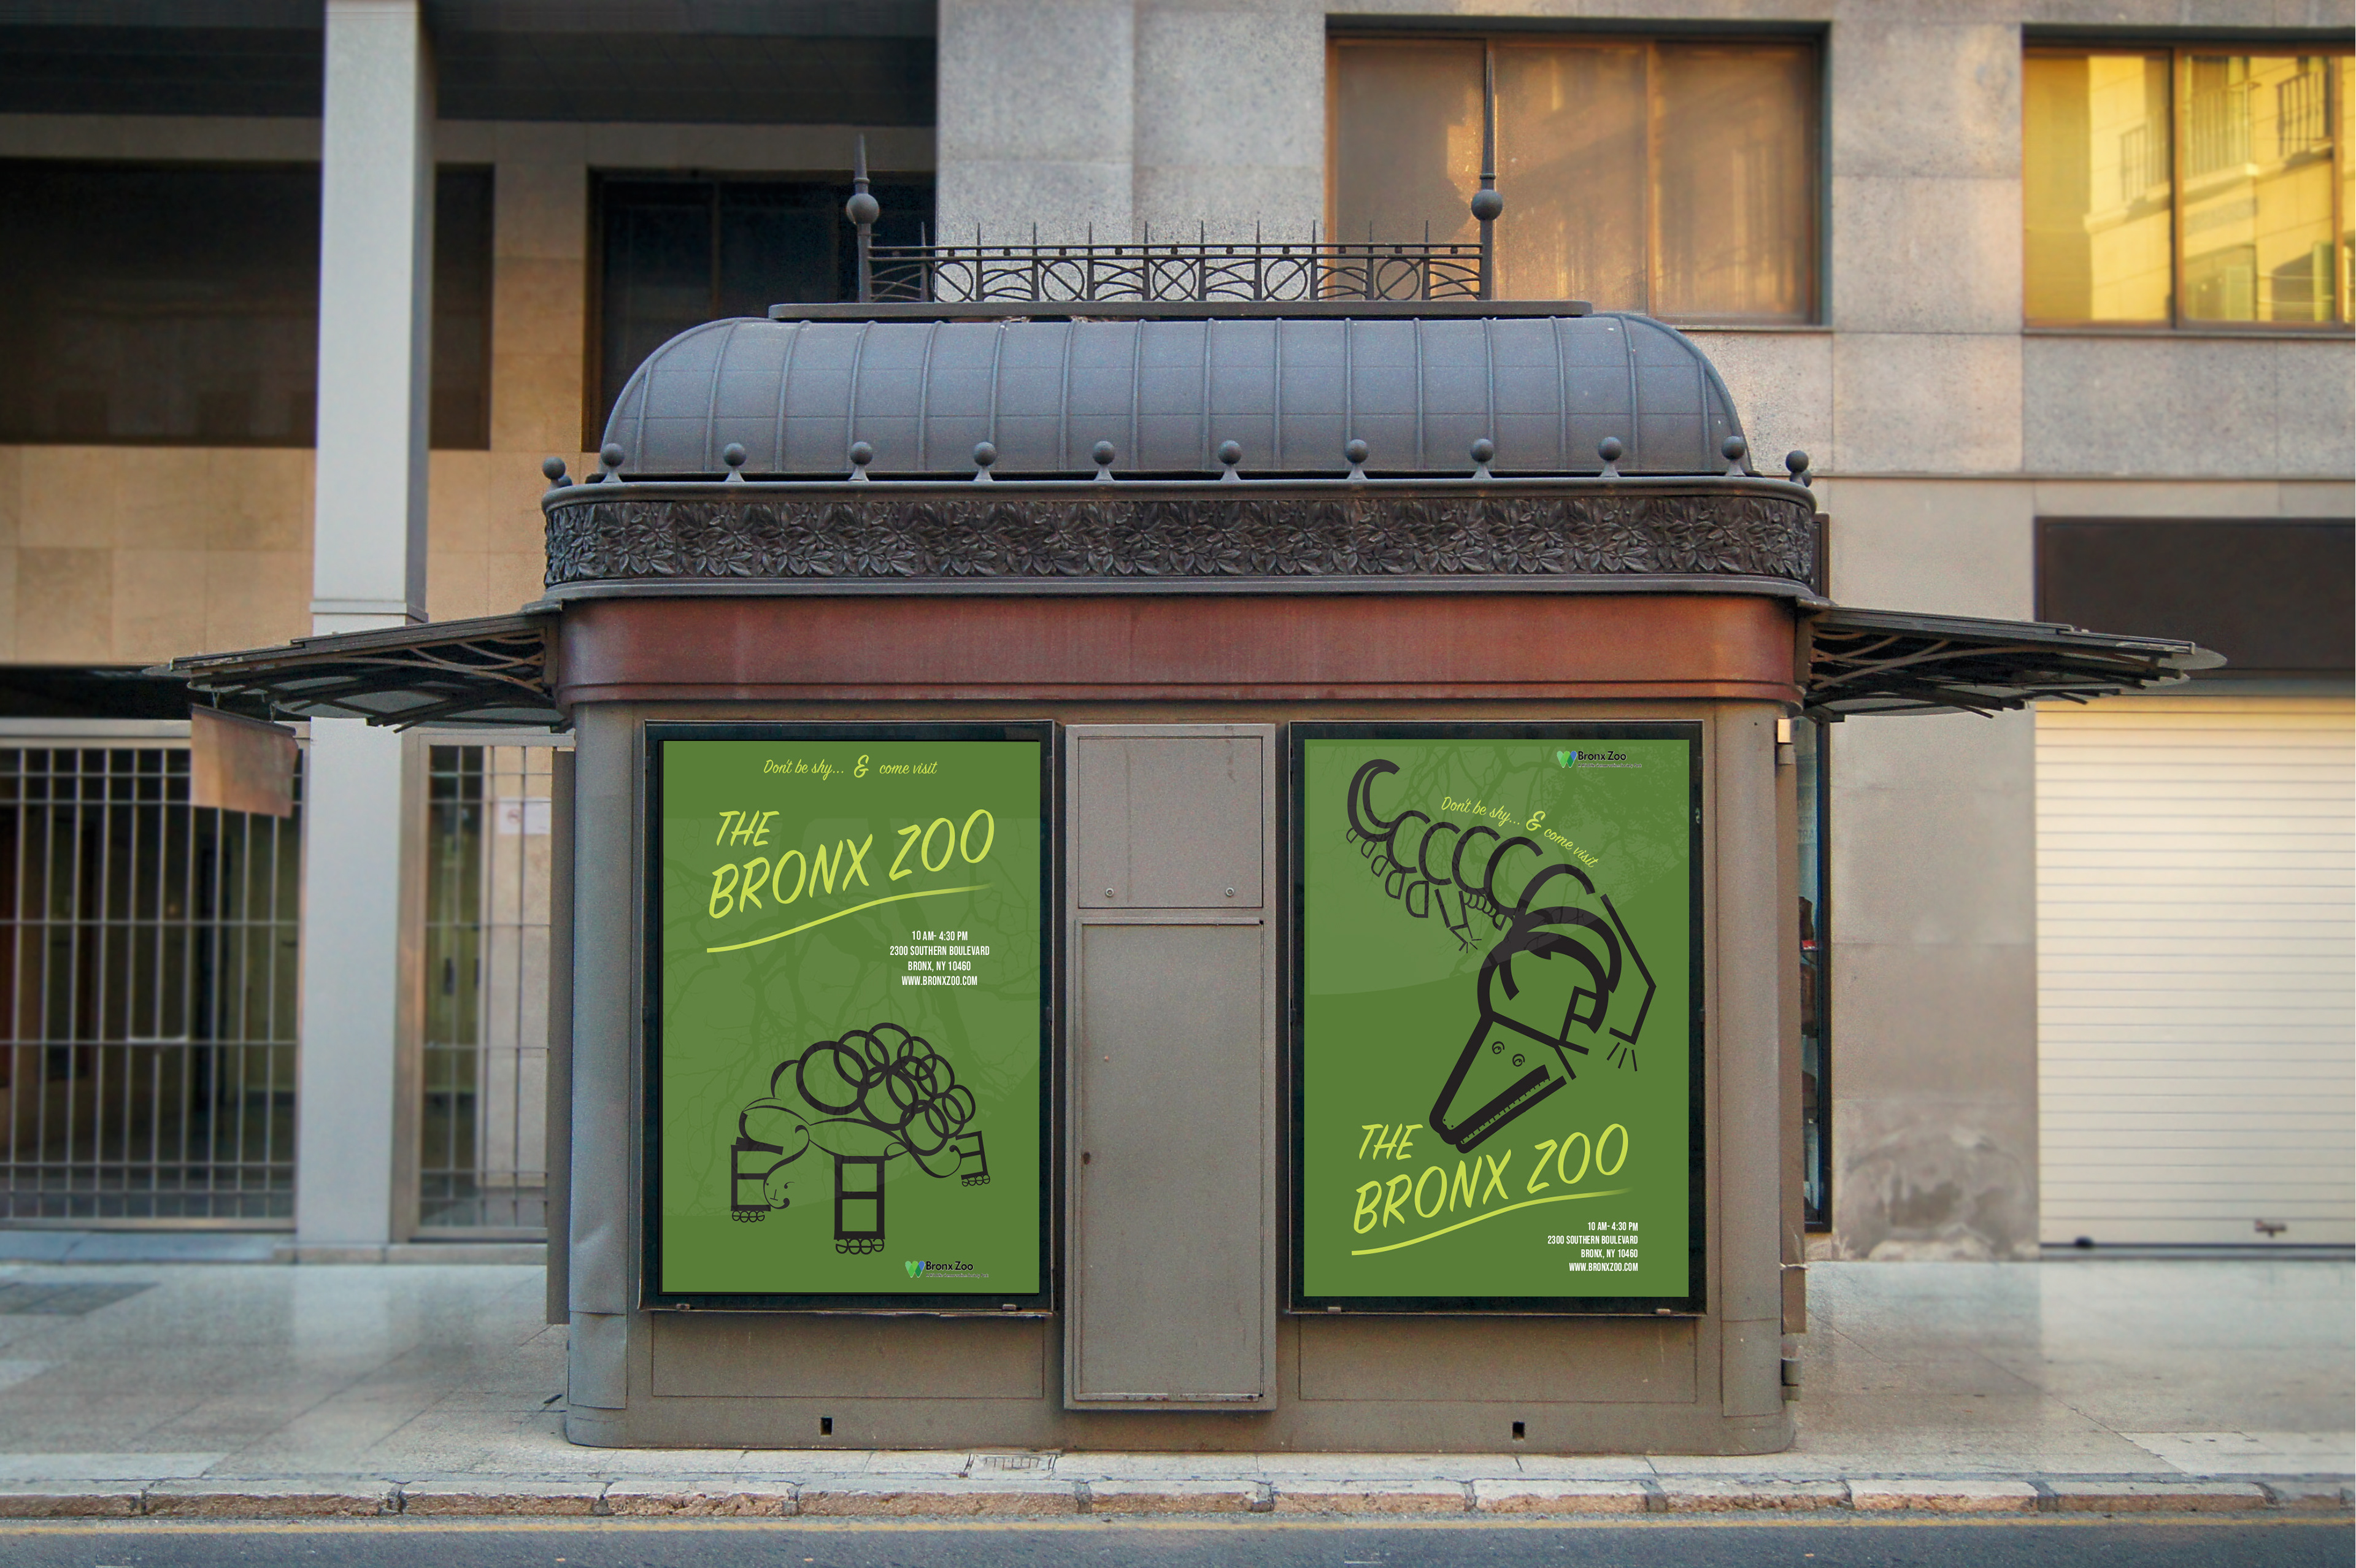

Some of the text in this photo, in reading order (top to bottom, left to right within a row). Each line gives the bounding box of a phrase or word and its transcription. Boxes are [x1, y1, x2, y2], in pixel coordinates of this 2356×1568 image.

[1577, 751, 1627, 761] Bronx Zoo
[763, 754, 938, 781] Don't be shy... & come visit
[716, 810, 780, 847] THE
[1441, 796, 1599, 868] Don't be shy... & come visit
[709, 809, 995, 919] BRONX ZOO
[912, 930, 922, 940] 10
[939, 931, 955, 941] 4:30
[957, 931, 968, 941] PM
[890, 945, 990, 956] 2300 SOUTHERN BOULEVARD
[907, 961, 971, 972] BRONX, NY 10460
[901, 975, 977, 986] WWW.BRONXZOO.COM
[1358, 1123, 1424, 1161] THE
[1353, 1123, 1629, 1234] BRONX ZOO
[1587, 1221, 1596, 1231] 10
[1611, 1221, 1627, 1231] 4:30
[1628, 1221, 1638, 1231] PM
[1547, 1235, 1638, 1245] 2300 SOUTHERN BOULEVARD
[1580, 1248, 1638, 1259] BRONX, NY 10460
[925, 1261, 974, 1270] Bronx Zoo
[1569, 1262, 1638, 1272] WWW.BRONXZOO.COM
